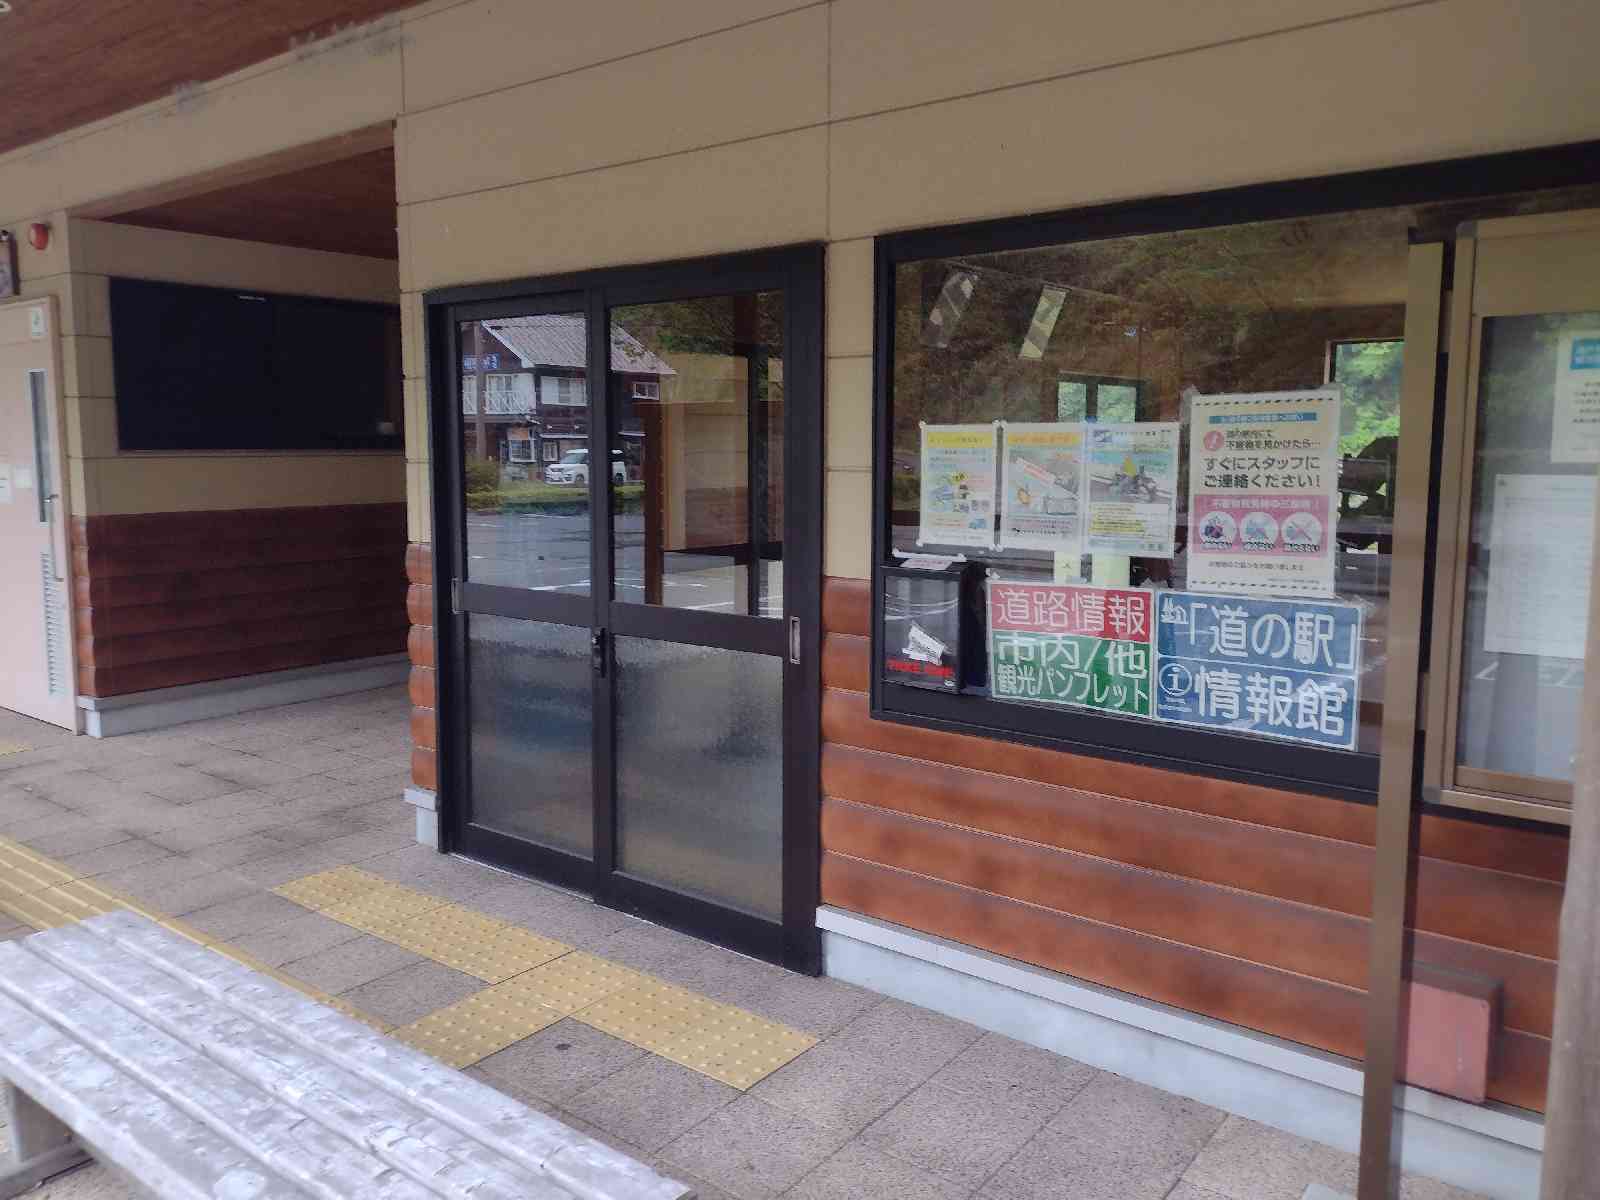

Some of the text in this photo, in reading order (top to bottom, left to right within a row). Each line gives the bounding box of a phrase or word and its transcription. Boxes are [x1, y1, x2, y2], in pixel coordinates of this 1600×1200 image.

[1204, 456, 1320, 471] すぐにスタッフに
[998, 588, 1145, 635] 道路情報
[996, 632, 1147, 679] 市内/他
[1190, 602, 1356, 670] 「道の駅」
[997, 664, 1148, 712] 観光パンフレット
[1194, 665, 1348, 737] 情報館
